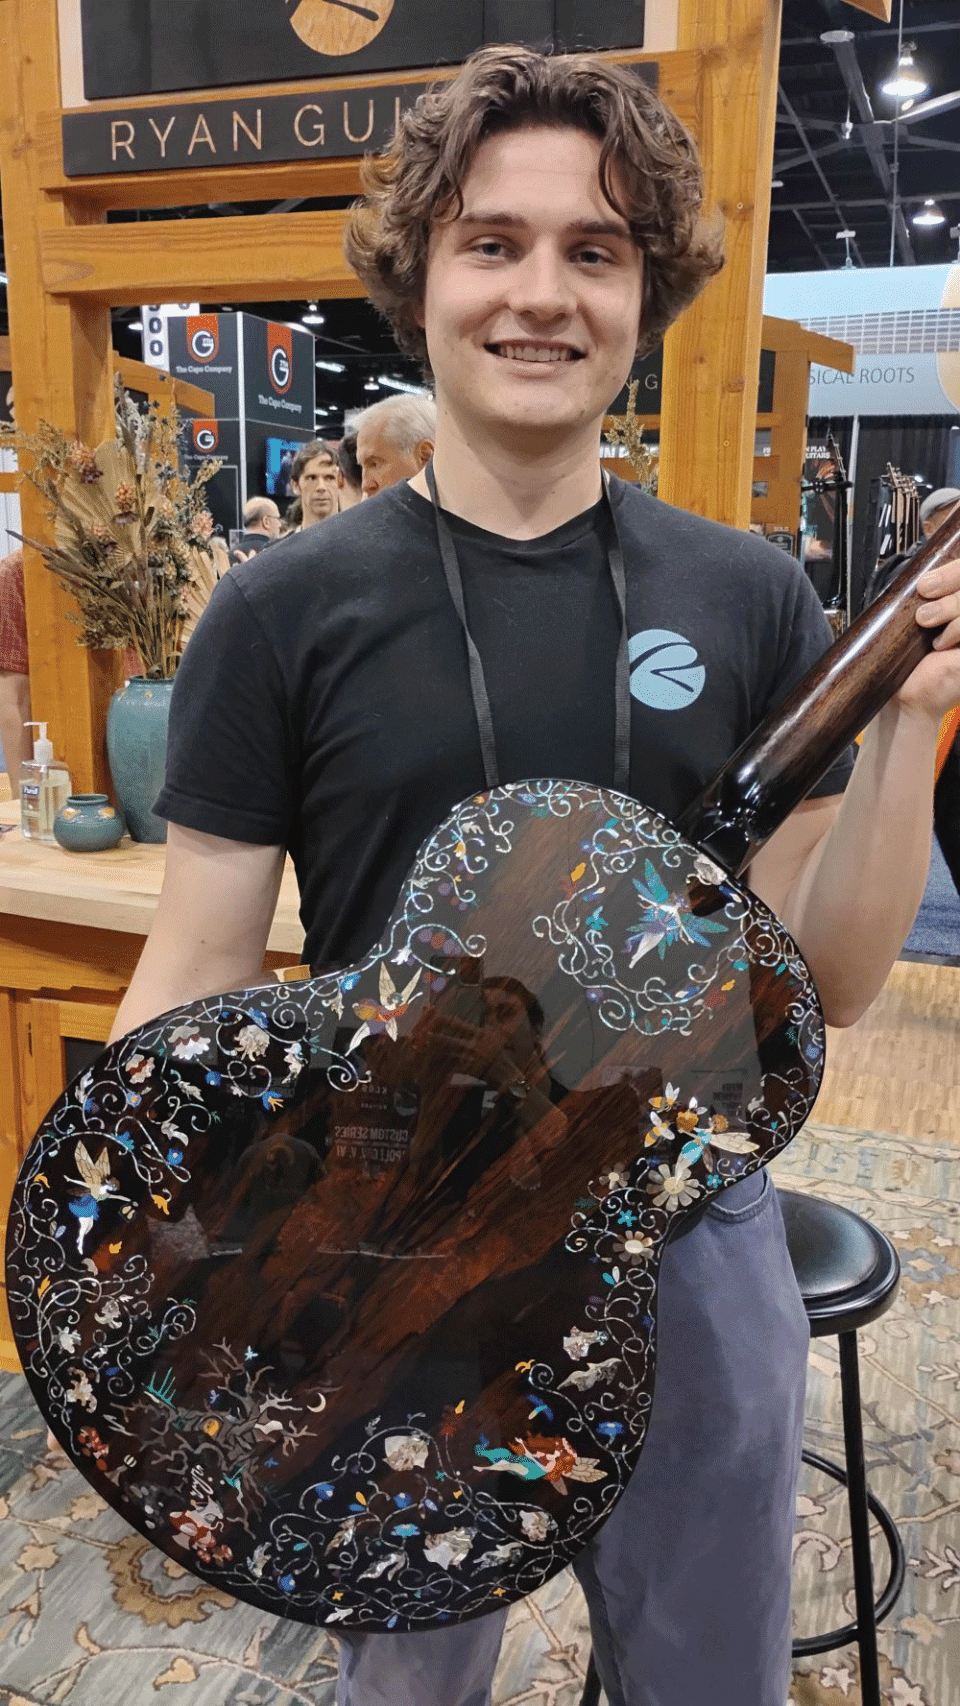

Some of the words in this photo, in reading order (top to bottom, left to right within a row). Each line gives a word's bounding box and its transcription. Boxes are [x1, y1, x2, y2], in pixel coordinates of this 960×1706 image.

[110, 108, 262, 161] RYAN
[294, 97, 400, 147] GUI
[148, 305, 163, 356] 00
[175, 365, 188, 373] The
[204, 365, 233, 374] Company
[809, 369, 854, 385] SICAL
[860, 367, 915, 384] ROOTS
[258, 393, 269, 405] The
[281, 398, 303, 414] Company
